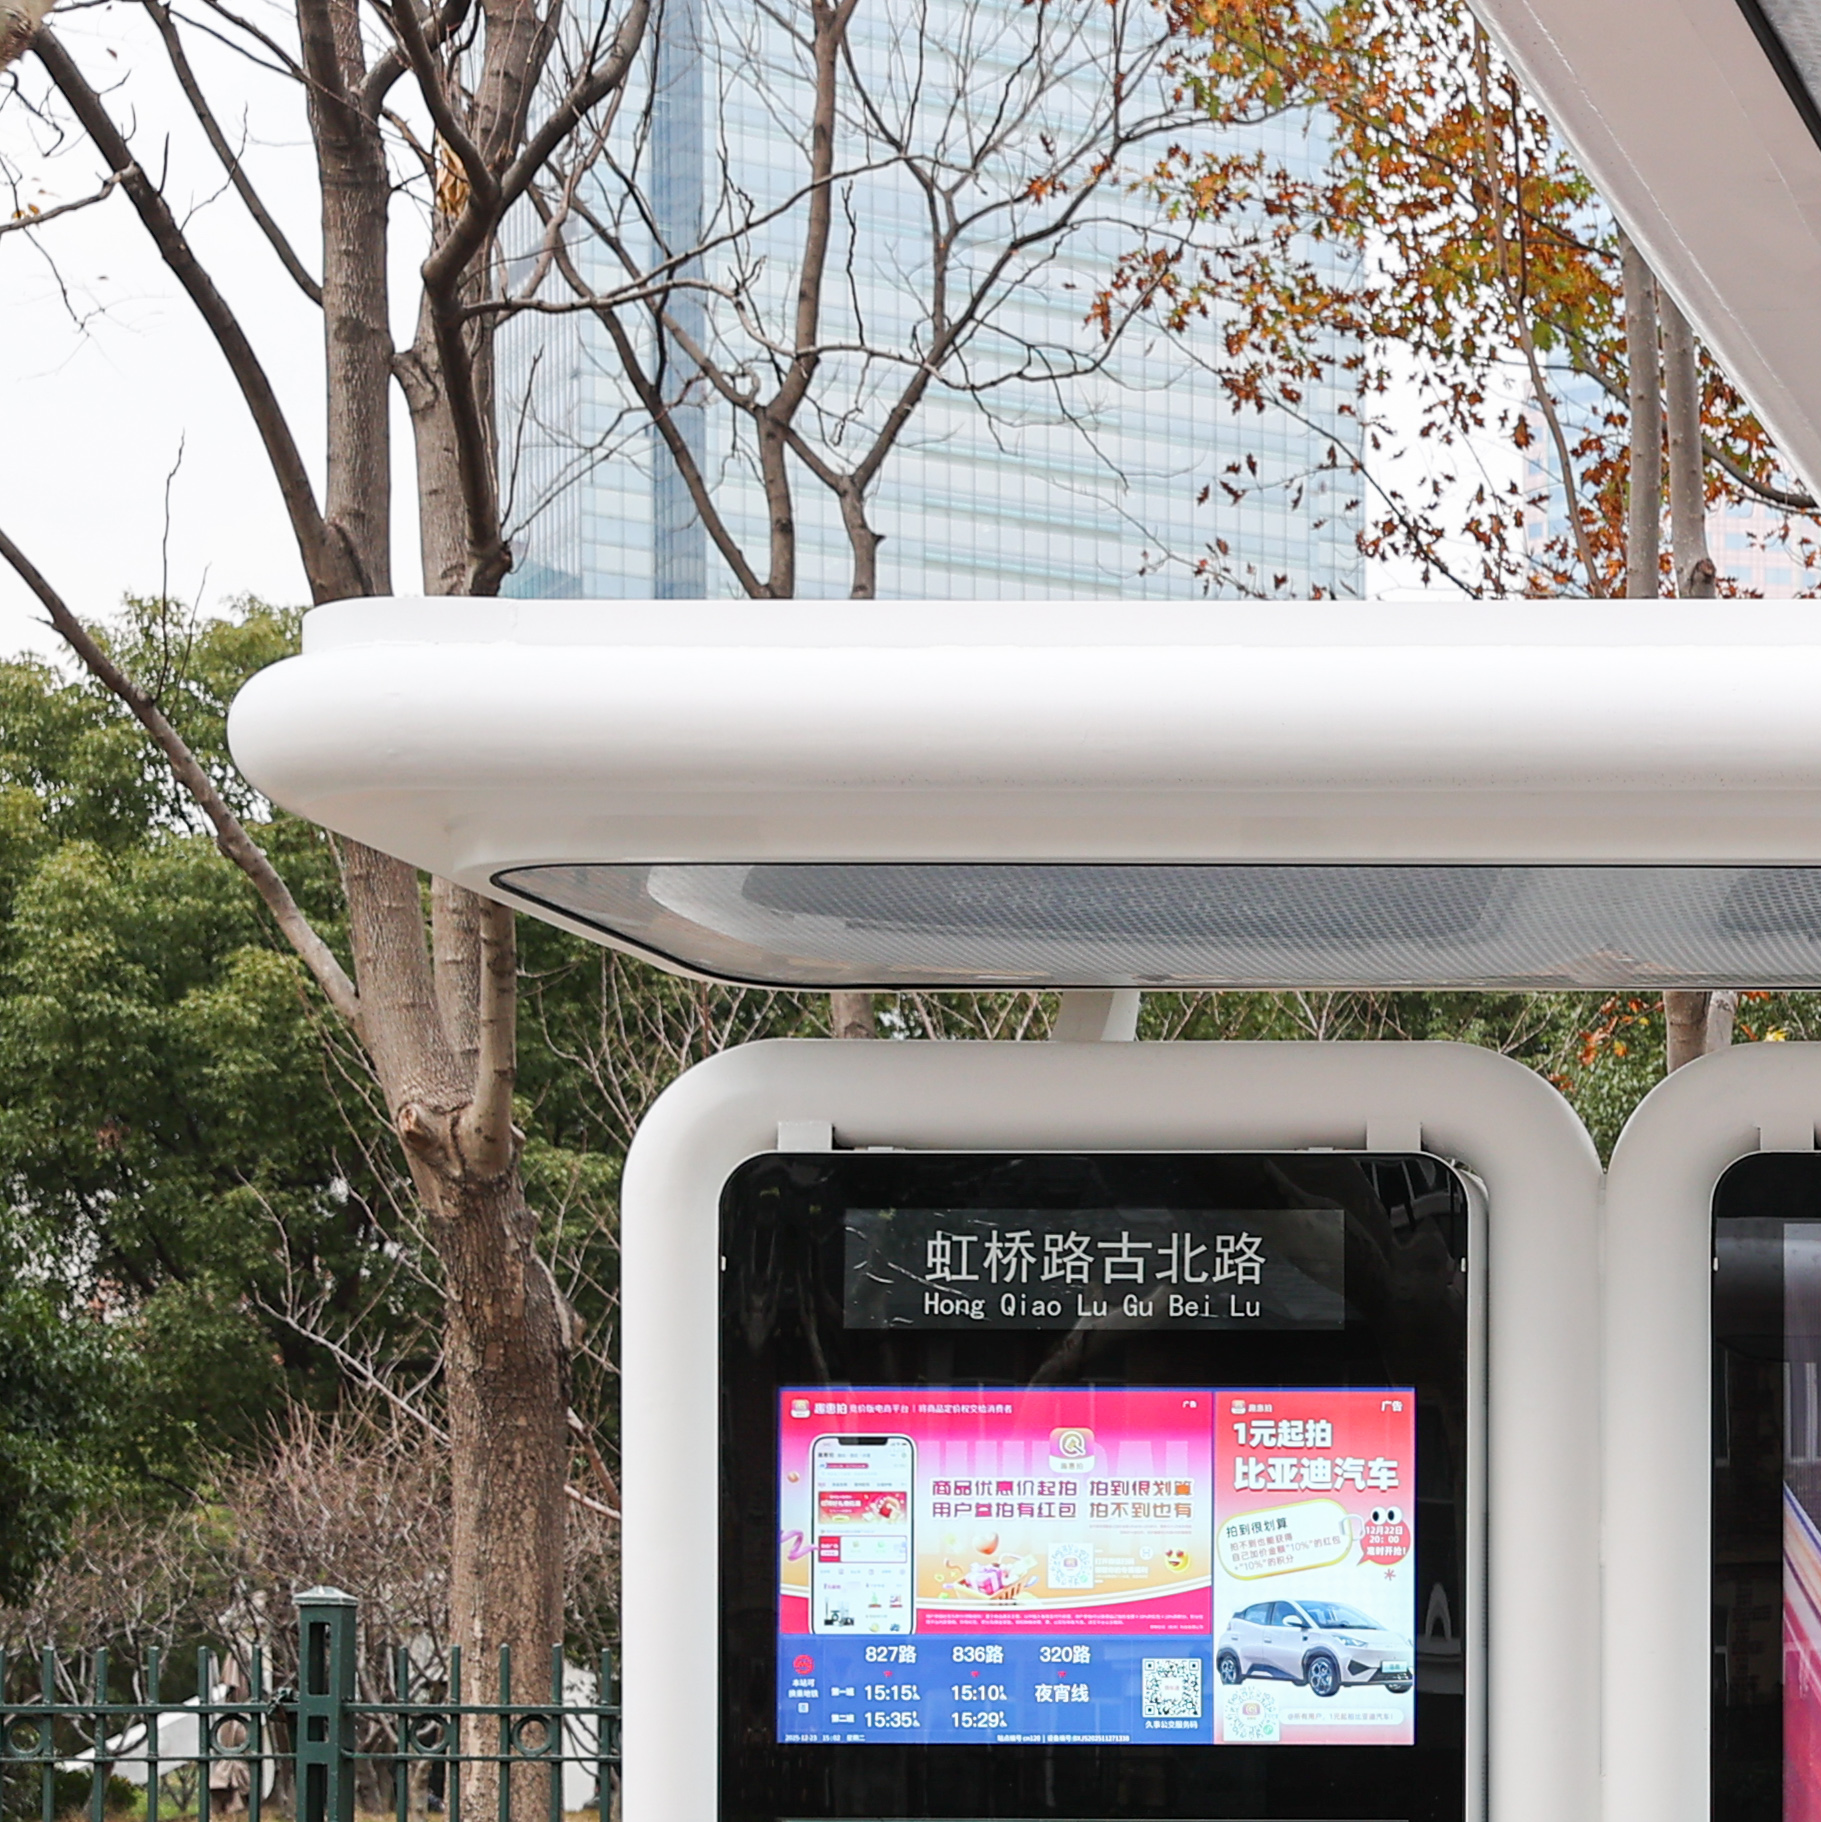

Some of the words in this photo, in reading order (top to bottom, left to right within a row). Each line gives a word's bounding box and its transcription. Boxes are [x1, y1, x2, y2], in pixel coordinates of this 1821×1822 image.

[924, 1231, 1266, 1286] 虹桥路古北路
[924, 1292, 985, 1319] Hong
[1000, 1292, 1062, 1318] Qiao
[1077, 1293, 1108, 1317] Lu
[1123, 1293, 1154, 1318] Gu
[1169, 1293, 1213, 1317] Bei
[1230, 1294, 1261, 1318] Lu
[1381, 1401, 1403, 1412] 广告
[1232, 1419, 1333, 1449] 1元起拍
[1232, 1457, 1399, 1492] 比亚迪汽车
[931, 1480, 1078, 1497] 商品优惠价起拍
[1089, 1480, 1194, 1497] 拍到很划算
[1089, 1502, 1193, 1519] 拍不到也有
[1226, 1517, 1288, 1538] 拍到很划算
[864, 1644, 918, 1664] 827路
[952, 1644, 1004, 1664] 836路
[1039, 1645, 1091, 1664] 320路
[864, 1684, 912, 1701] 15:15
[951, 1684, 999, 1701] 15:10
[1034, 1684, 1090, 1703] 夜宵线
[864, 1711, 912, 1728] 15:35
[951, 1711, 999, 1728] 15:29
